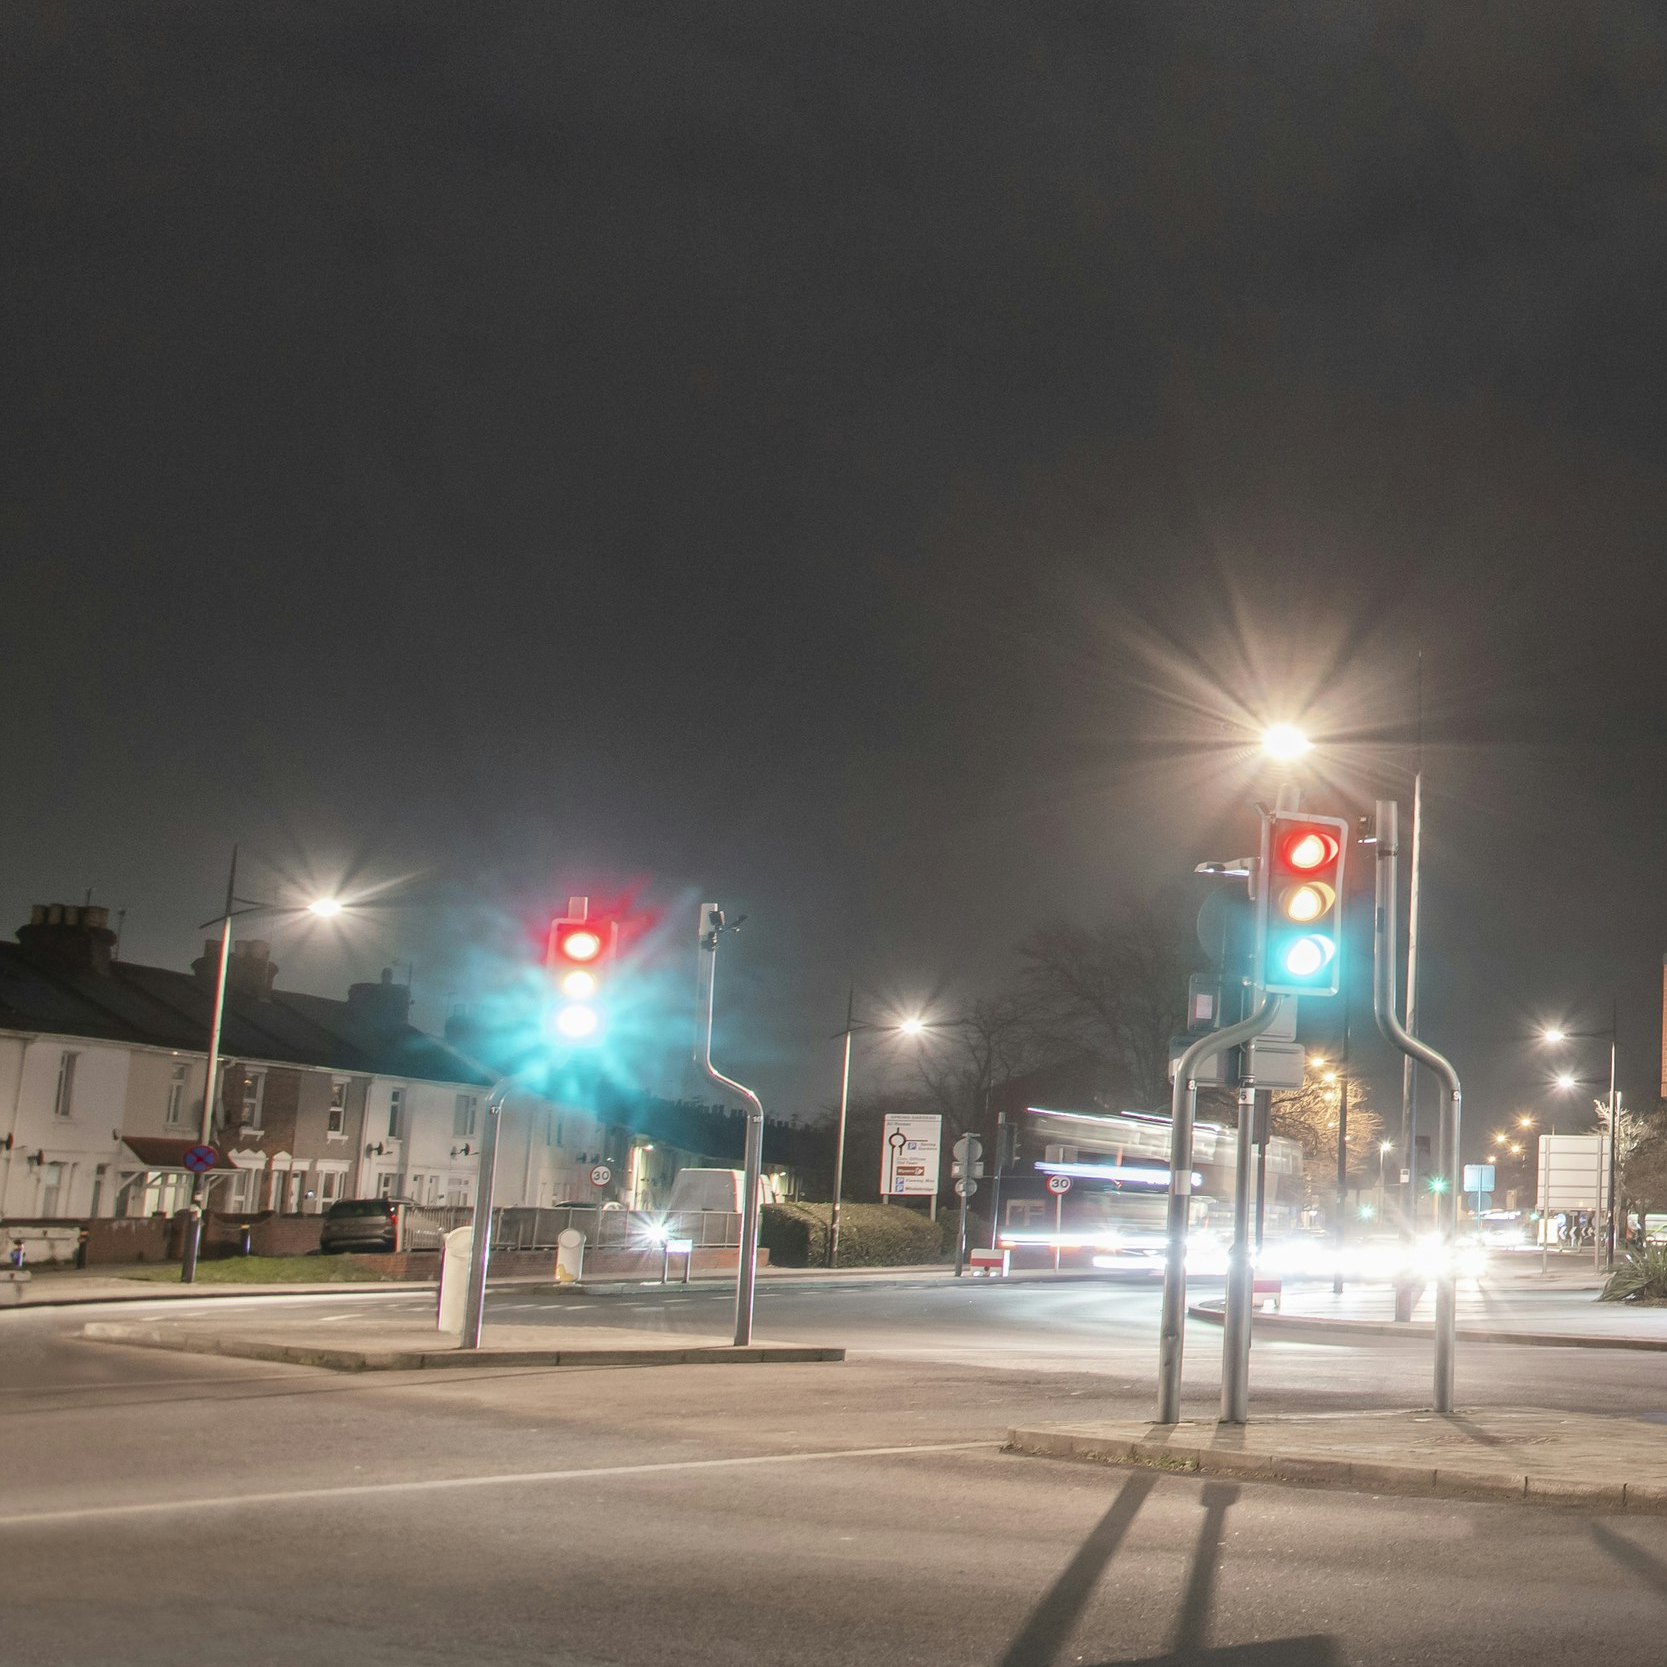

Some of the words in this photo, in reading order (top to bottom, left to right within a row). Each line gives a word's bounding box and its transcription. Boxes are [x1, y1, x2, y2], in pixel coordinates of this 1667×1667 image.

[1188, 1079, 1195, 1090] 8
[593, 1169, 610, 1181] 30
[1051, 1178, 1069, 1189] 30
